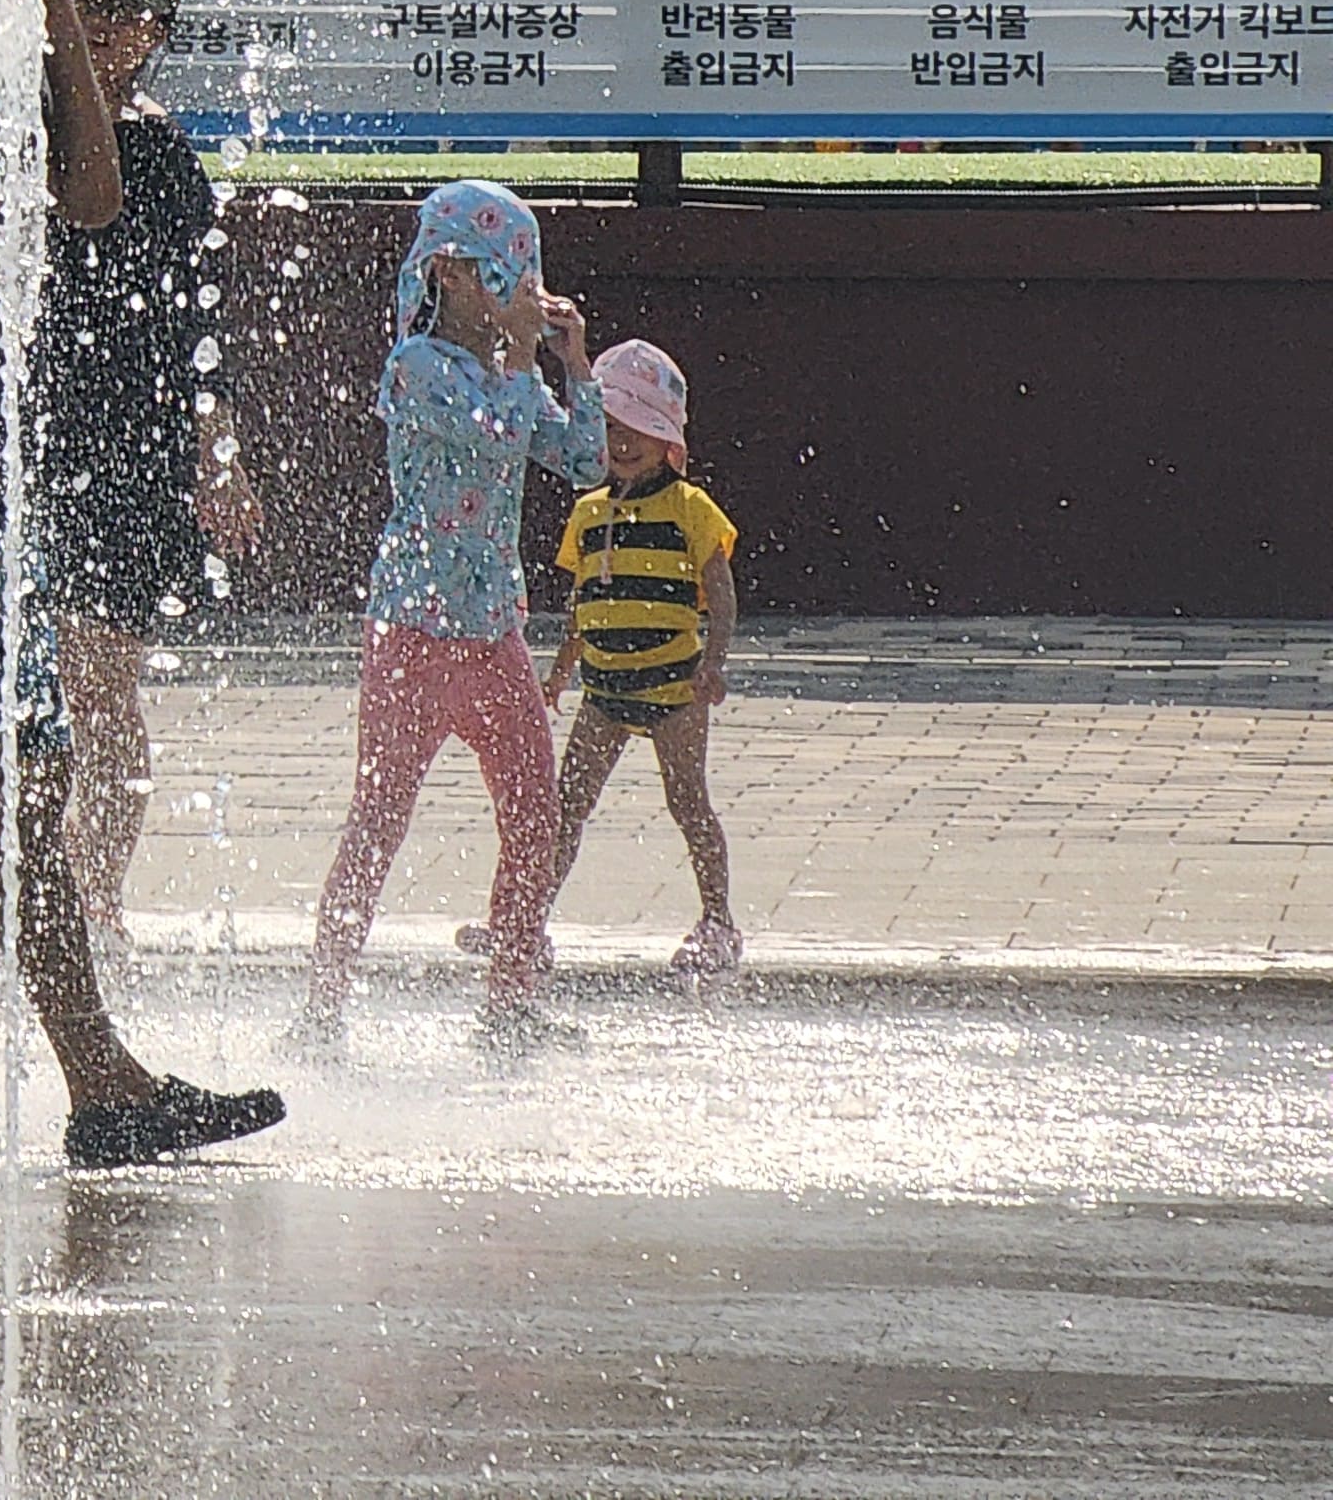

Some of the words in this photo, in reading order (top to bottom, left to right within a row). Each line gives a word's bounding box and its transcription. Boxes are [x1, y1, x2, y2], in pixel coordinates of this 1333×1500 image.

[381, 2, 579, 39] 구토설사증상
[661, 3, 797, 40] 반려동물
[927, 3, 1032, 40] 음식물
[1123, 2, 1225, 40] 자전거
[1238, 2, 1333, 40] 킥보드
[412, 49, 546, 87] 이용금지
[660, 49, 795, 87] 출입금지
[909, 49, 1045, 87] 반입금지
[1164, 49, 1299, 87] 출입금지
